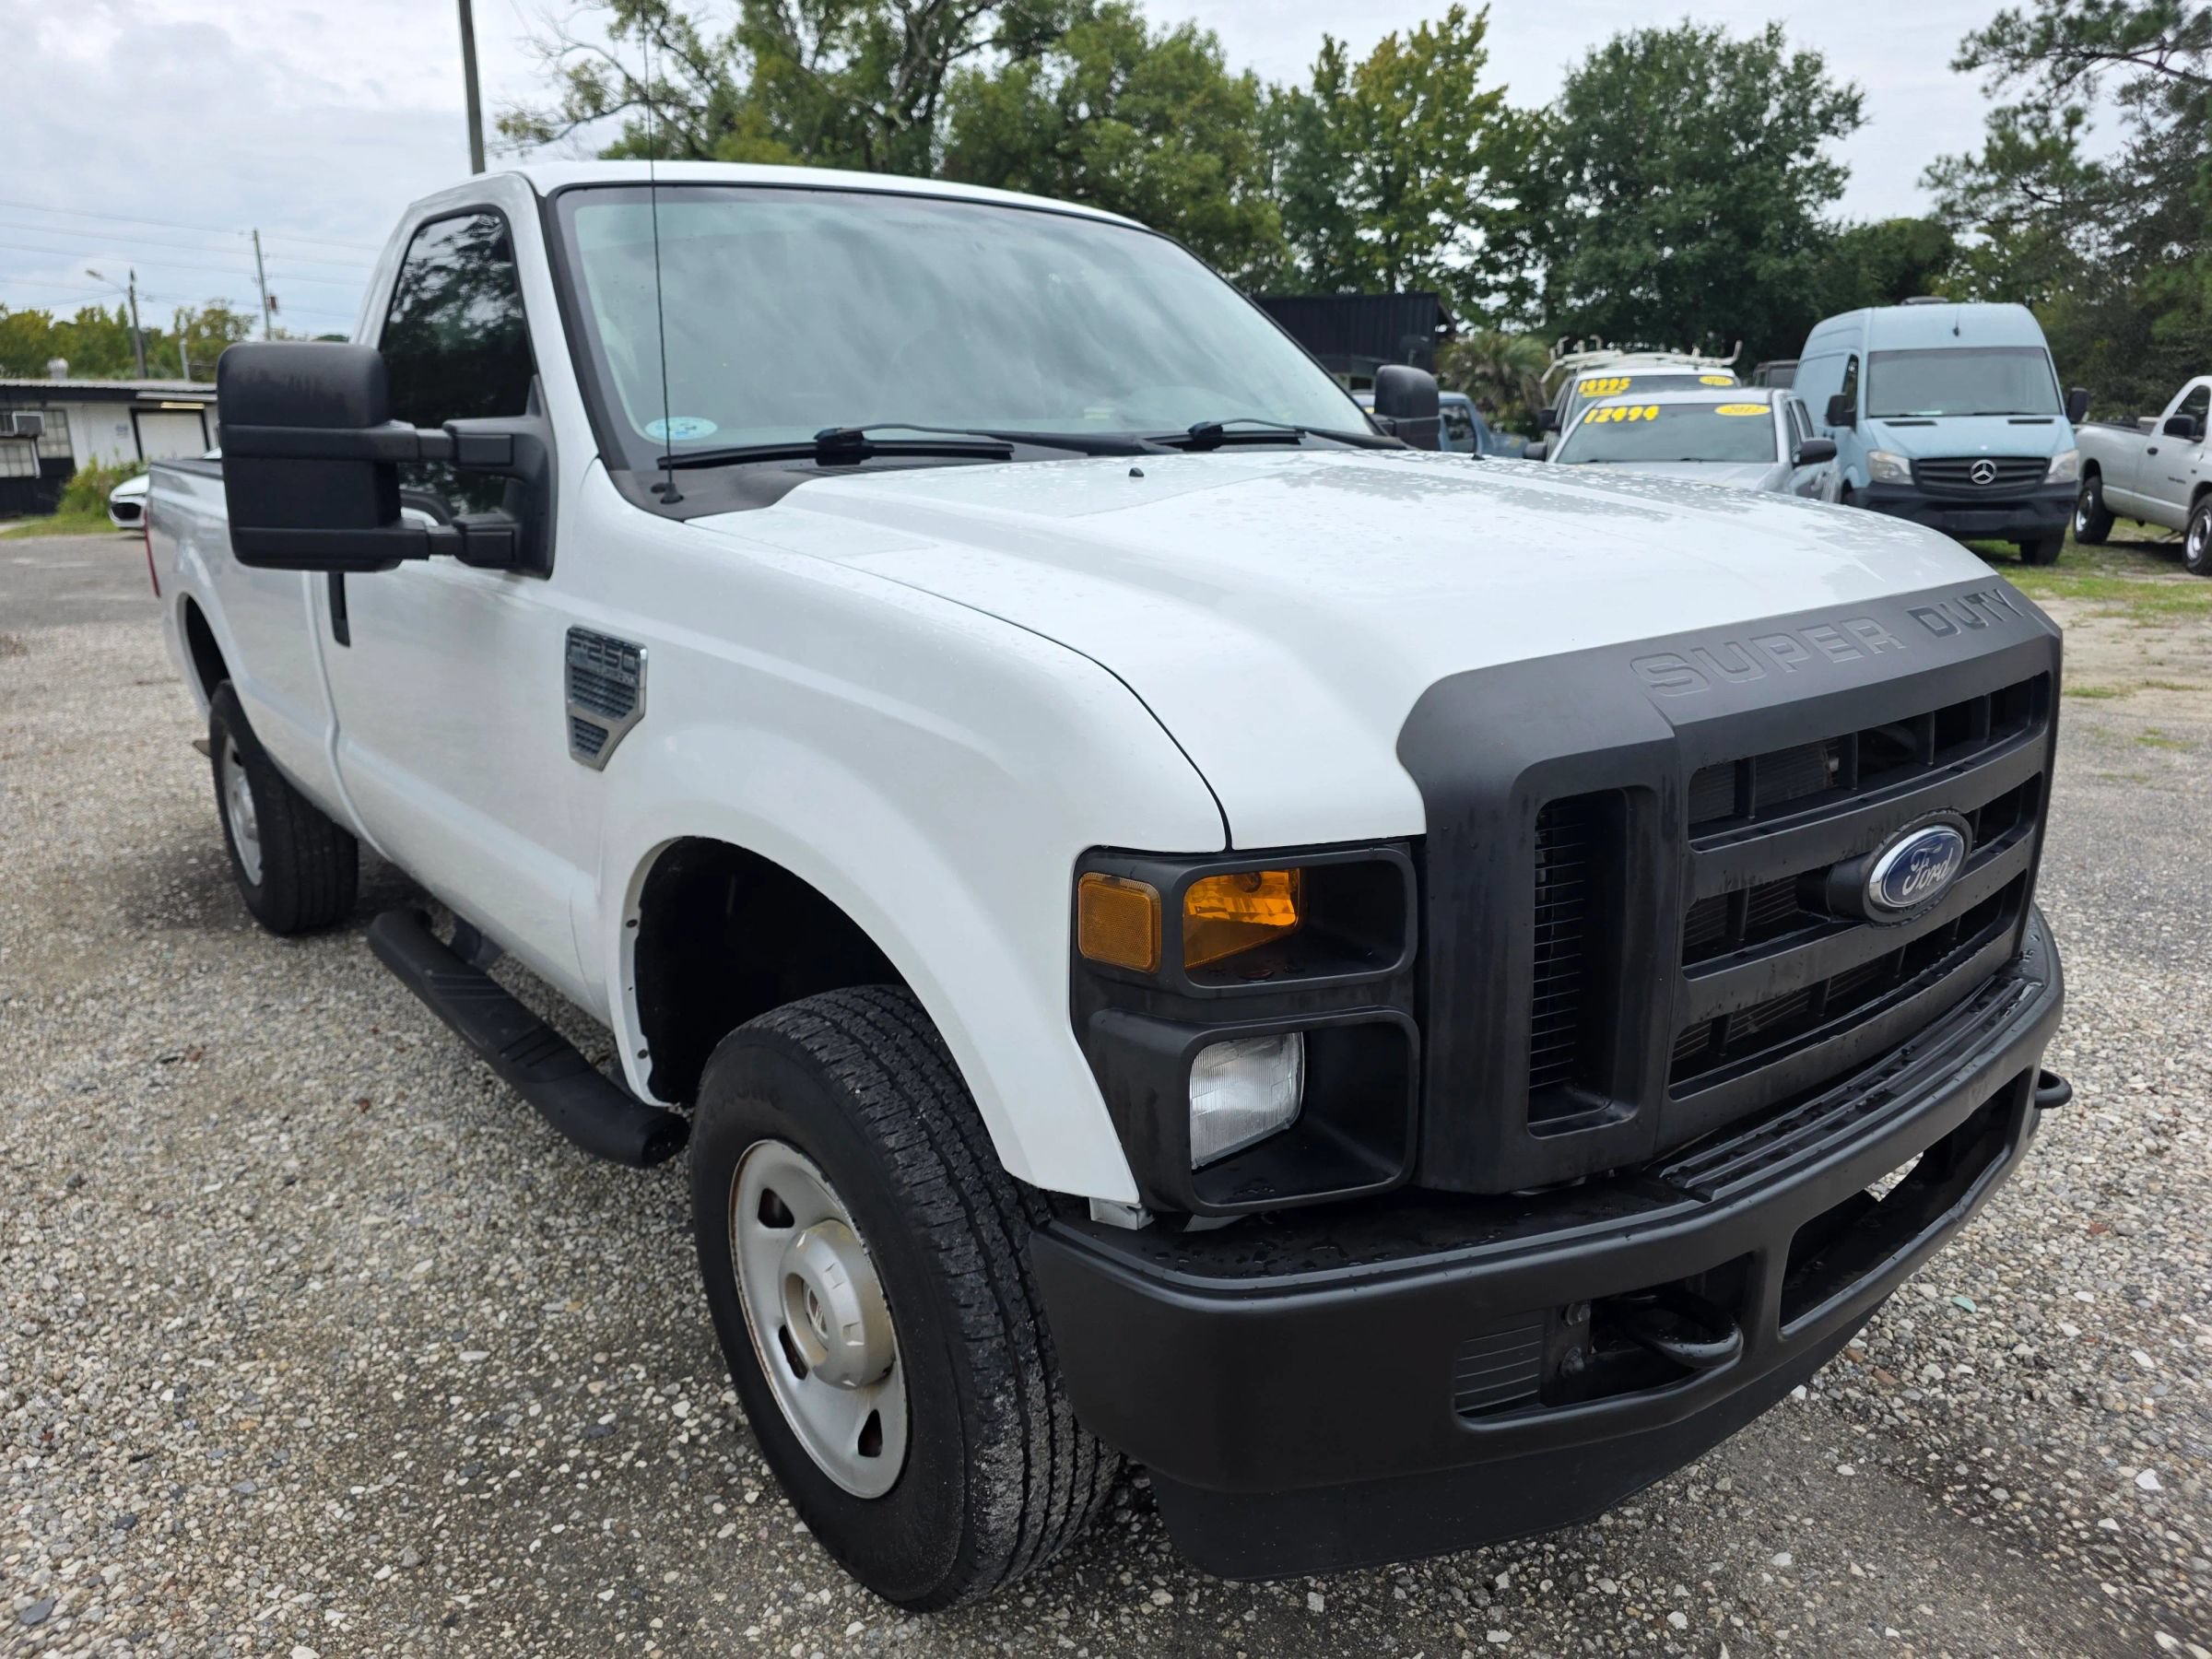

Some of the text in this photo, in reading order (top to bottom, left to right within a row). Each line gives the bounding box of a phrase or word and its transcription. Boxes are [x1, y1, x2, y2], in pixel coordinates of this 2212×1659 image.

[1630, 588, 2025, 698] SUPER DUTY
[1901, 842, 1954, 896] Ford
